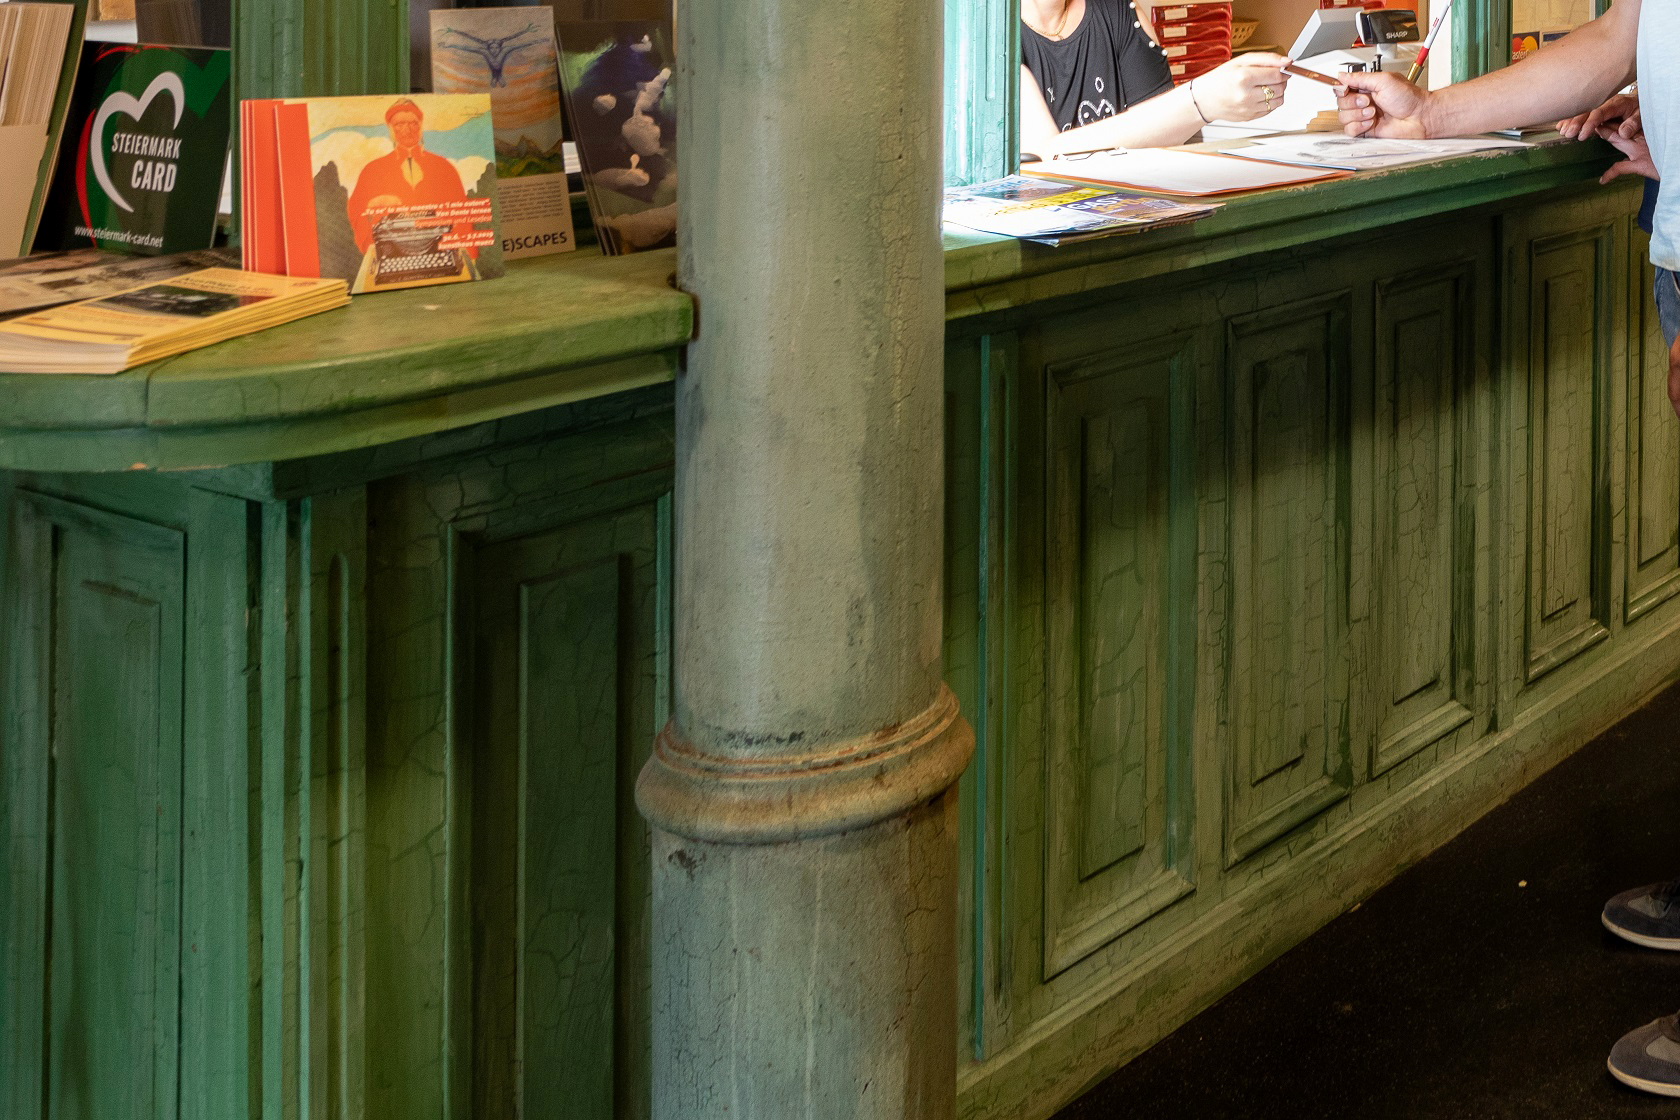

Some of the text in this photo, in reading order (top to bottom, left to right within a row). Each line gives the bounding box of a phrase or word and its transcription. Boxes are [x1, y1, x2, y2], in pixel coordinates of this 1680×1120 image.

[1385, 30, 1408, 40] SHARP
[111, 132, 183, 160] STEIERMARK
[131, 159, 178, 193] CARD
[74, 225, 164, 248] www.steiermark-card.net
[502, 231, 567, 252] E)SCAPES
